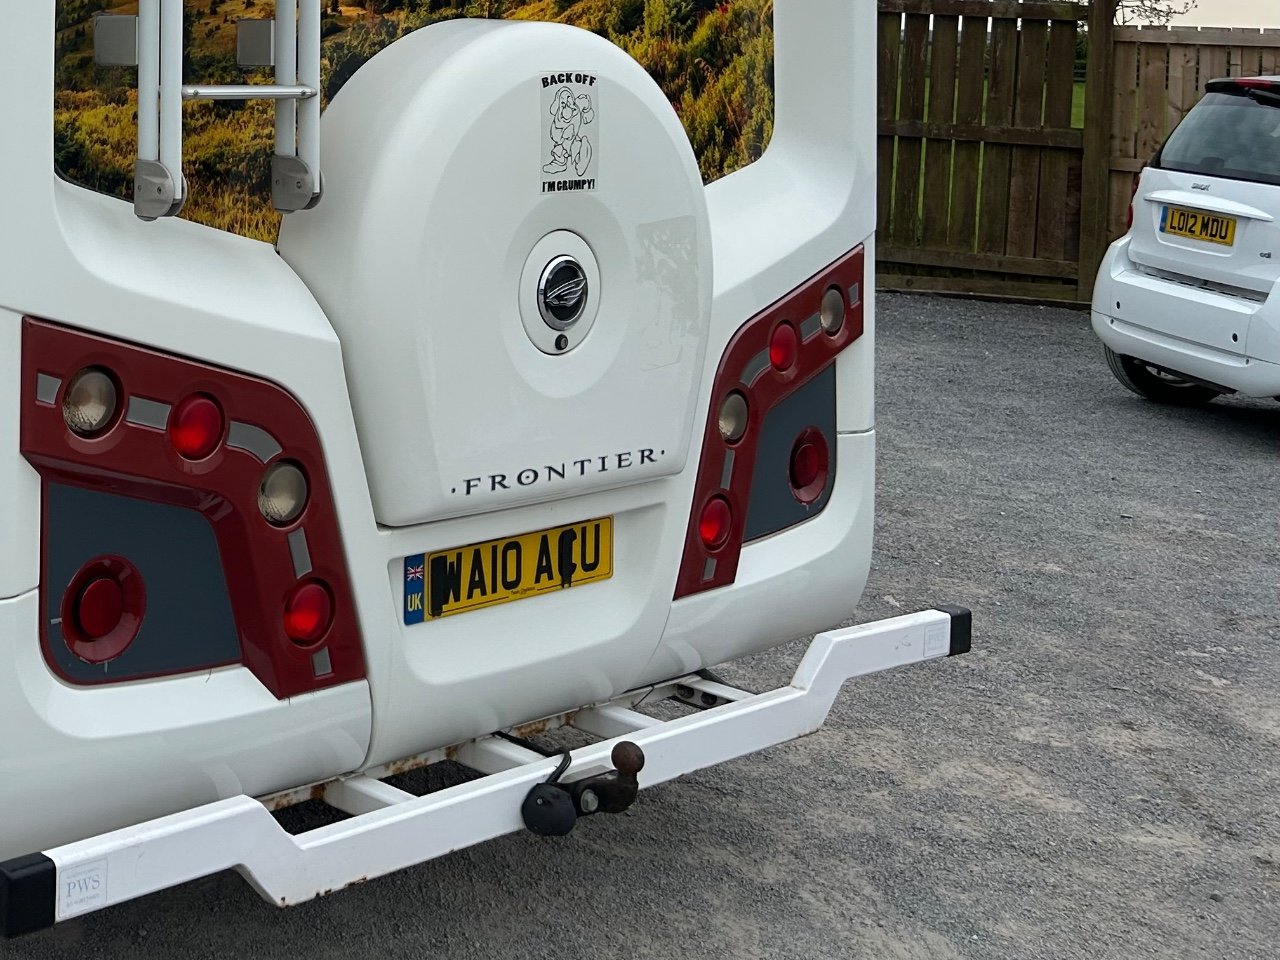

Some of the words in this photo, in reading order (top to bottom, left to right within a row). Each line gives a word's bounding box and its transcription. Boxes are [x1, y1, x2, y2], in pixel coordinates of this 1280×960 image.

[541, 73, 573, 88] BACK
[575, 73, 597, 87] OFF
[542, 180, 556, 193] I'M
[557, 178, 595, 191] GRUMPY!
[1169, 210, 1198, 234] LO12
[1200, 215, 1230, 240] MDU
[463, 448, 658, 496] FRONTIER
[407, 592, 422, 612] UK
[66, 873, 100, 898] PWS
